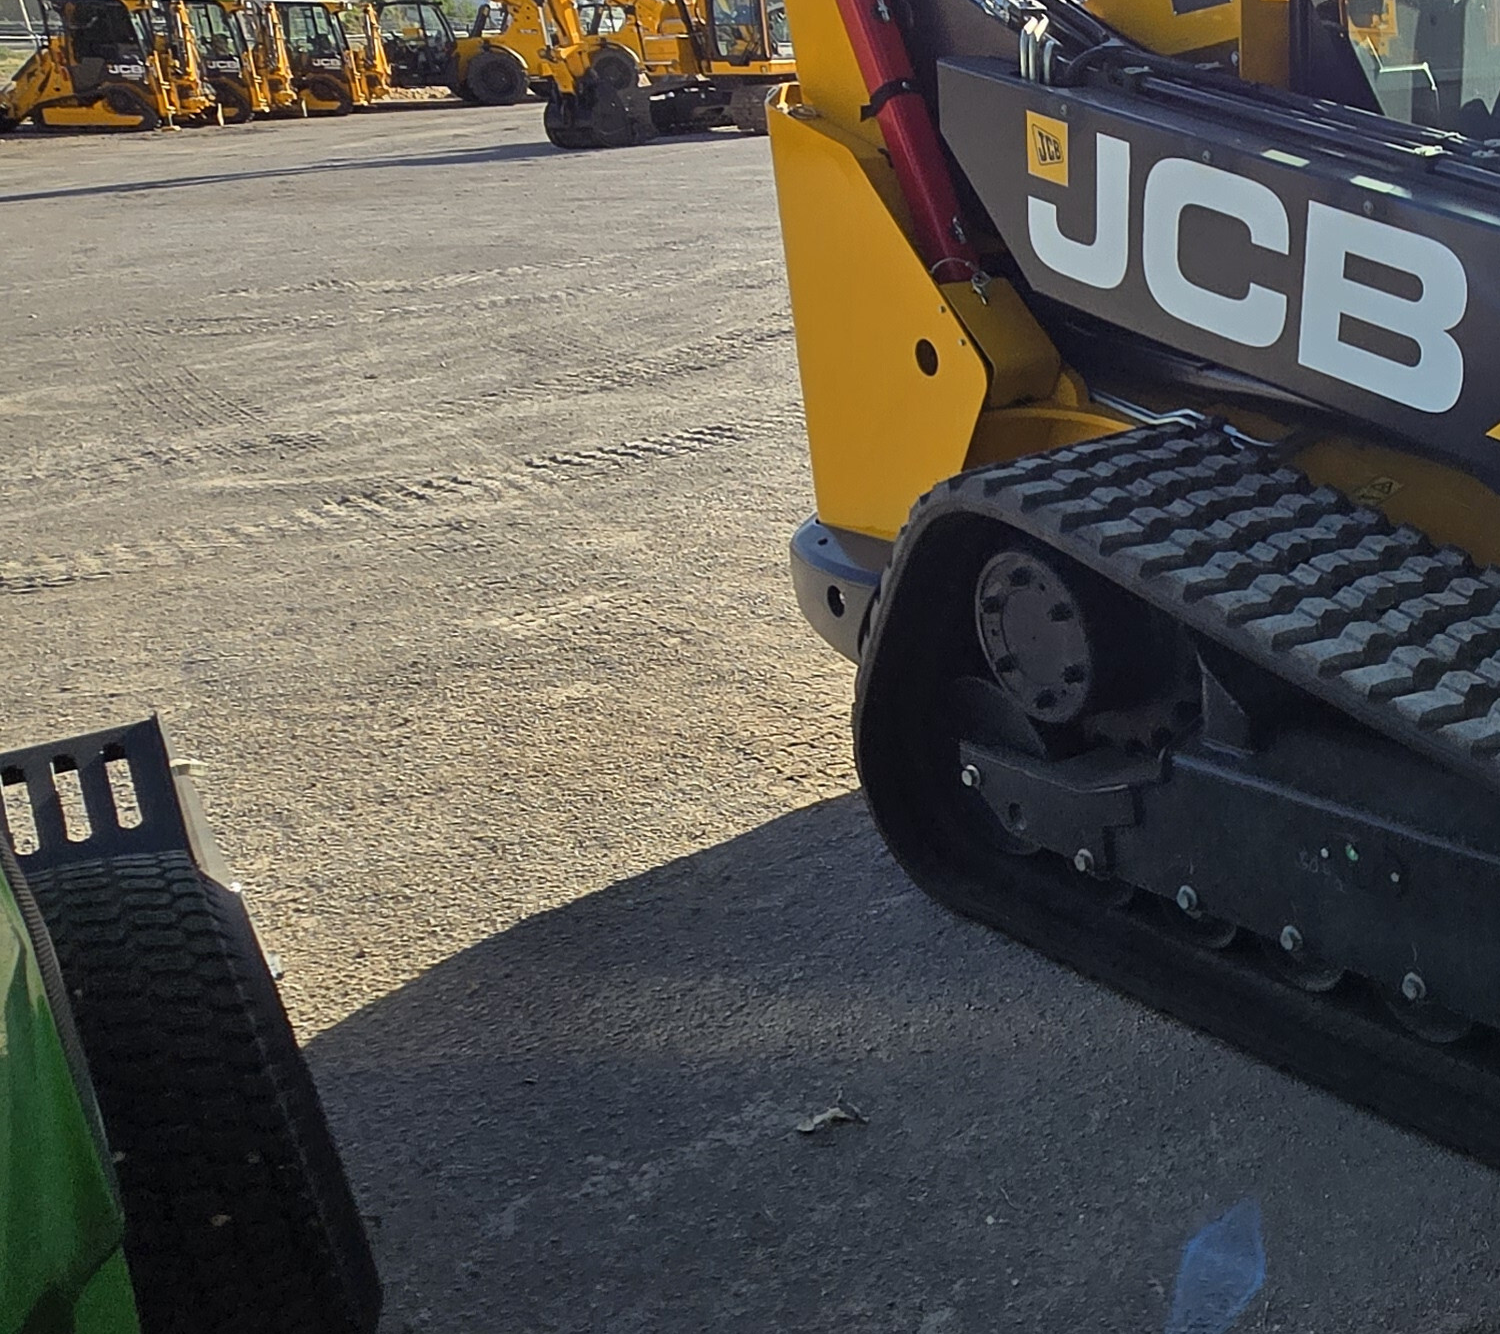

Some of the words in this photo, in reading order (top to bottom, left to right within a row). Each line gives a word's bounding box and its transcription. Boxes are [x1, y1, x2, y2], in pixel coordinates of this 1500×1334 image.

[207, 60, 239, 69] JCB
[311, 58, 341, 67] JCB
[108, 64, 145, 74] JCB
[1037, 129, 1062, 163] JCB
[1027, 132, 1468, 413] JCB
